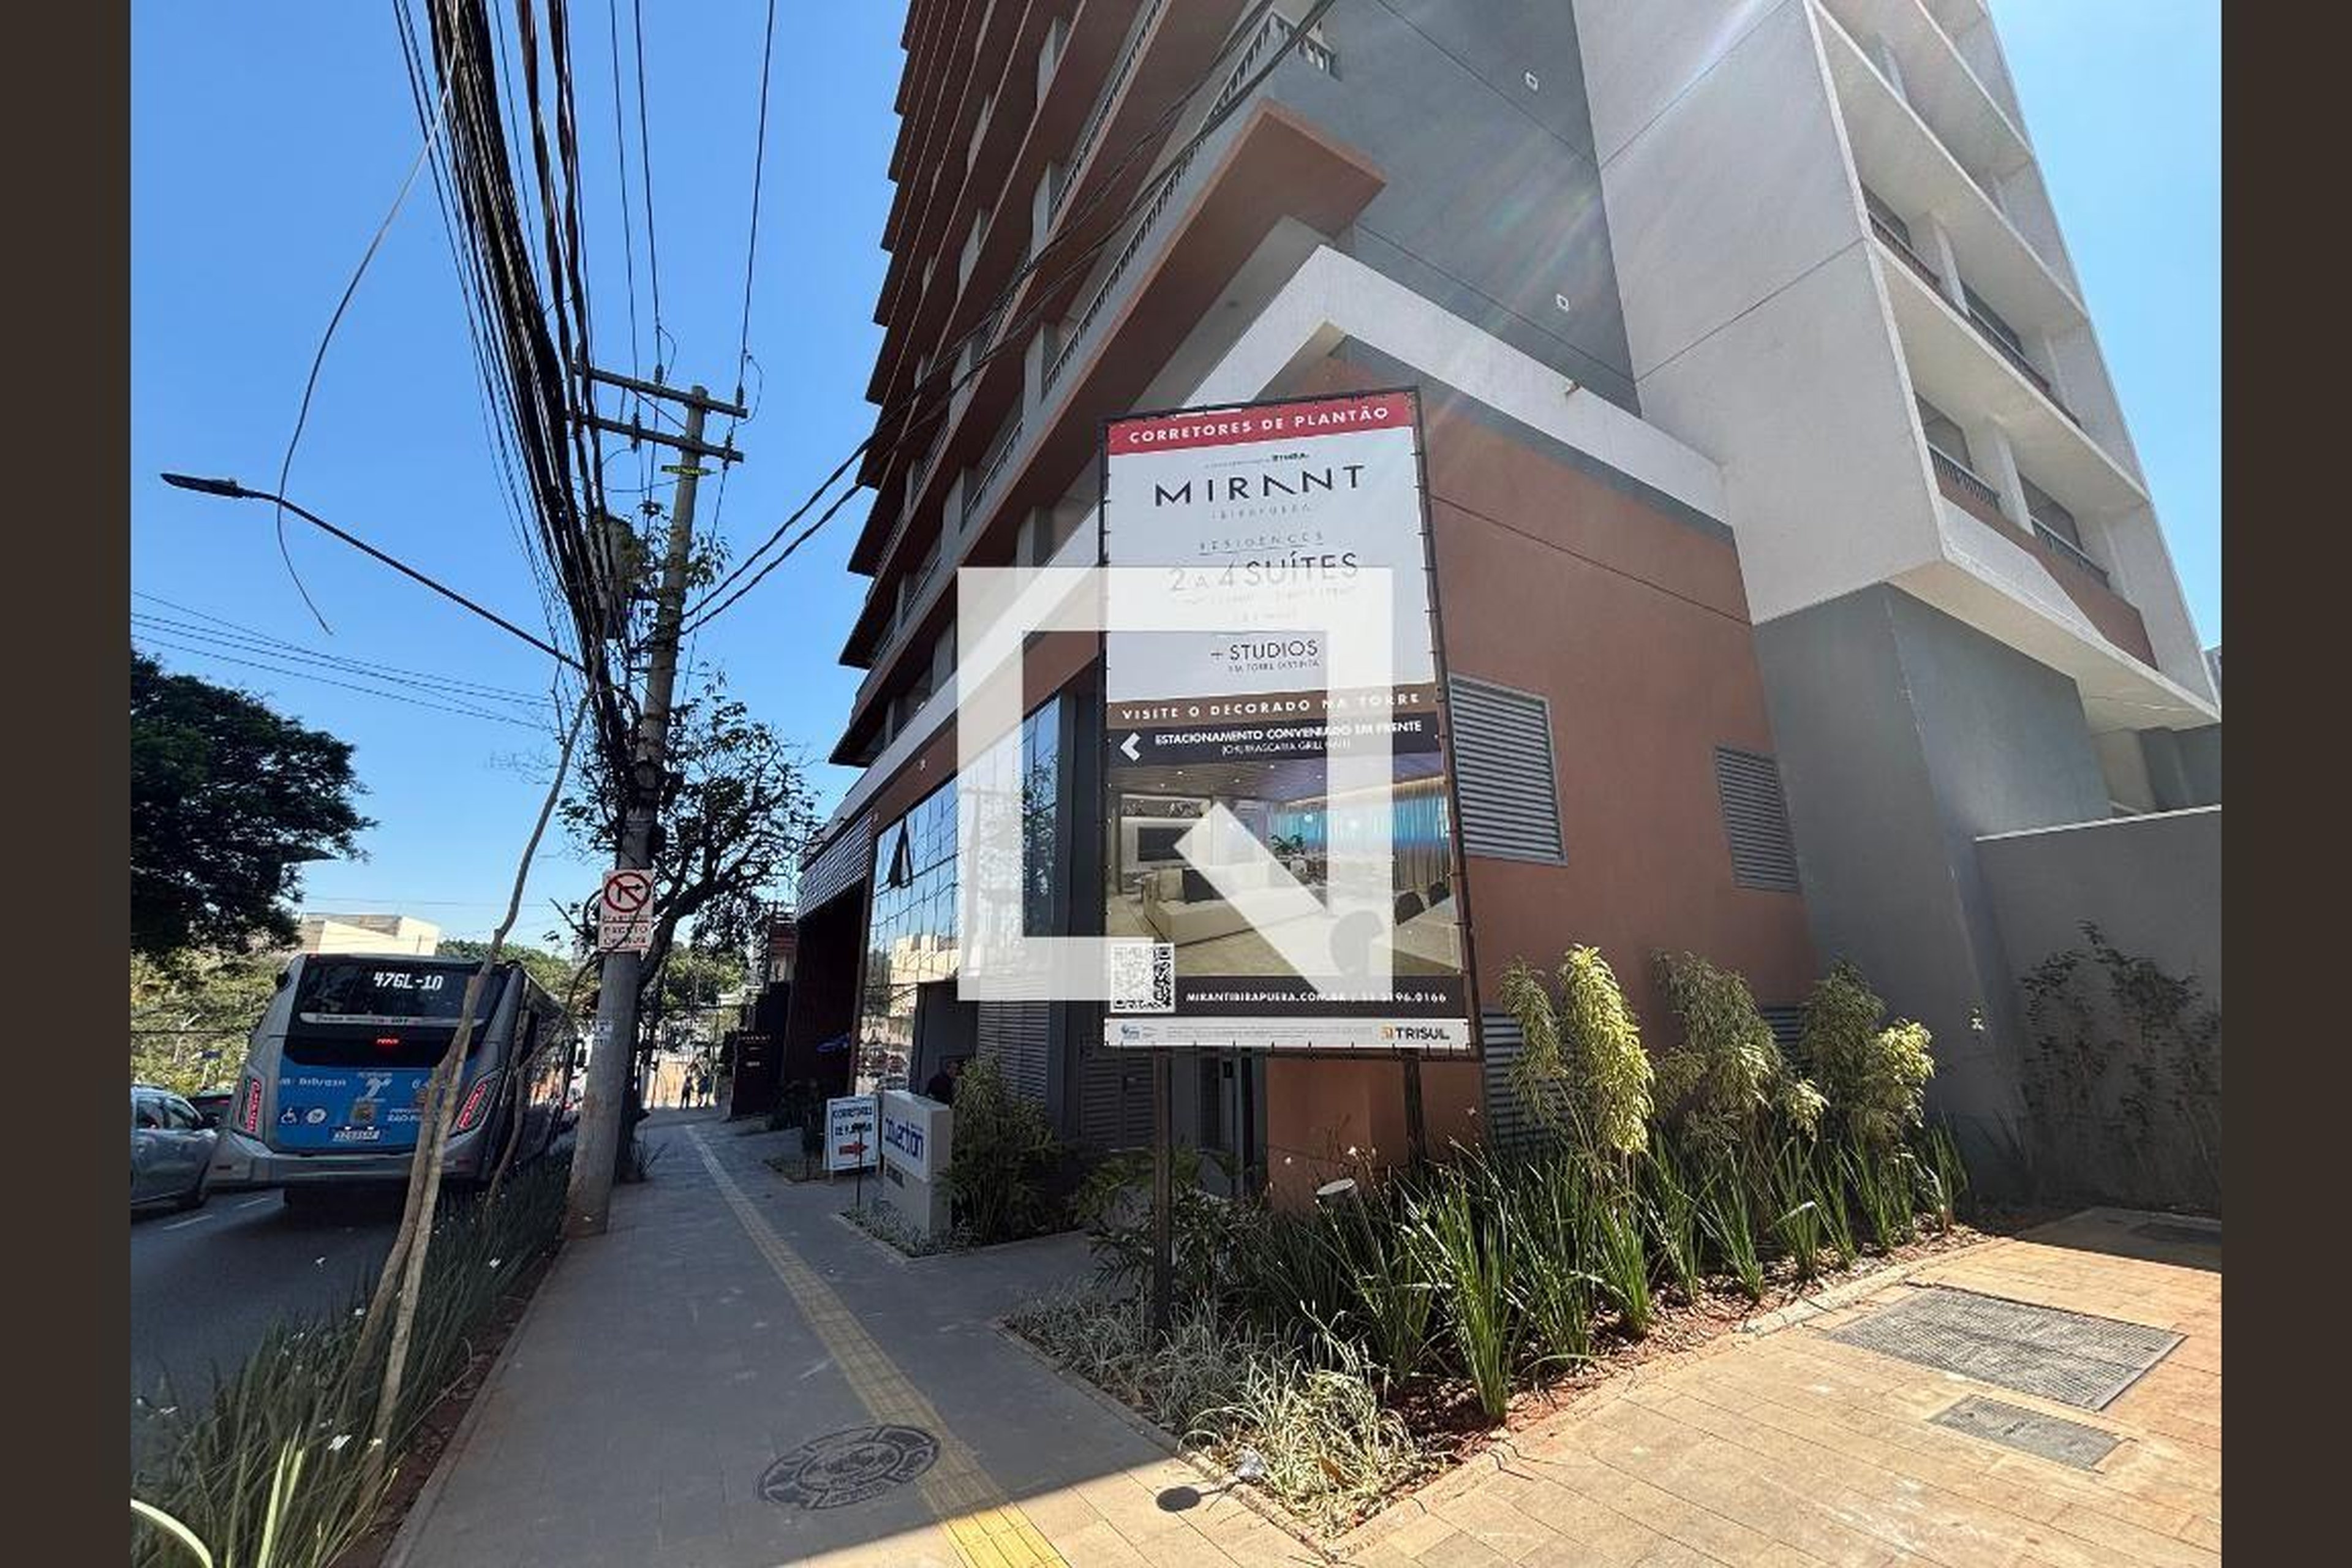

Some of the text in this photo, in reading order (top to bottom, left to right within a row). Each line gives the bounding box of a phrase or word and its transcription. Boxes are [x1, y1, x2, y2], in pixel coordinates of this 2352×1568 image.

[1129, 406, 1389, 443] CORRETORES DE PLANTÃO
[1243, 551, 1358, 586] SUÍTES
[1230, 639, 1319, 661] STUDIOS
[1122, 707, 1179, 720] VISITE
[1188, 706, 1200, 718] O
[1210, 699, 1311, 716] DECORADO
[1360, 693, 1420, 708] TORRE
[1155, 729, 1264, 745] ESTACIONAMENTO
[1395, 1027, 1450, 1040] TRISUL
